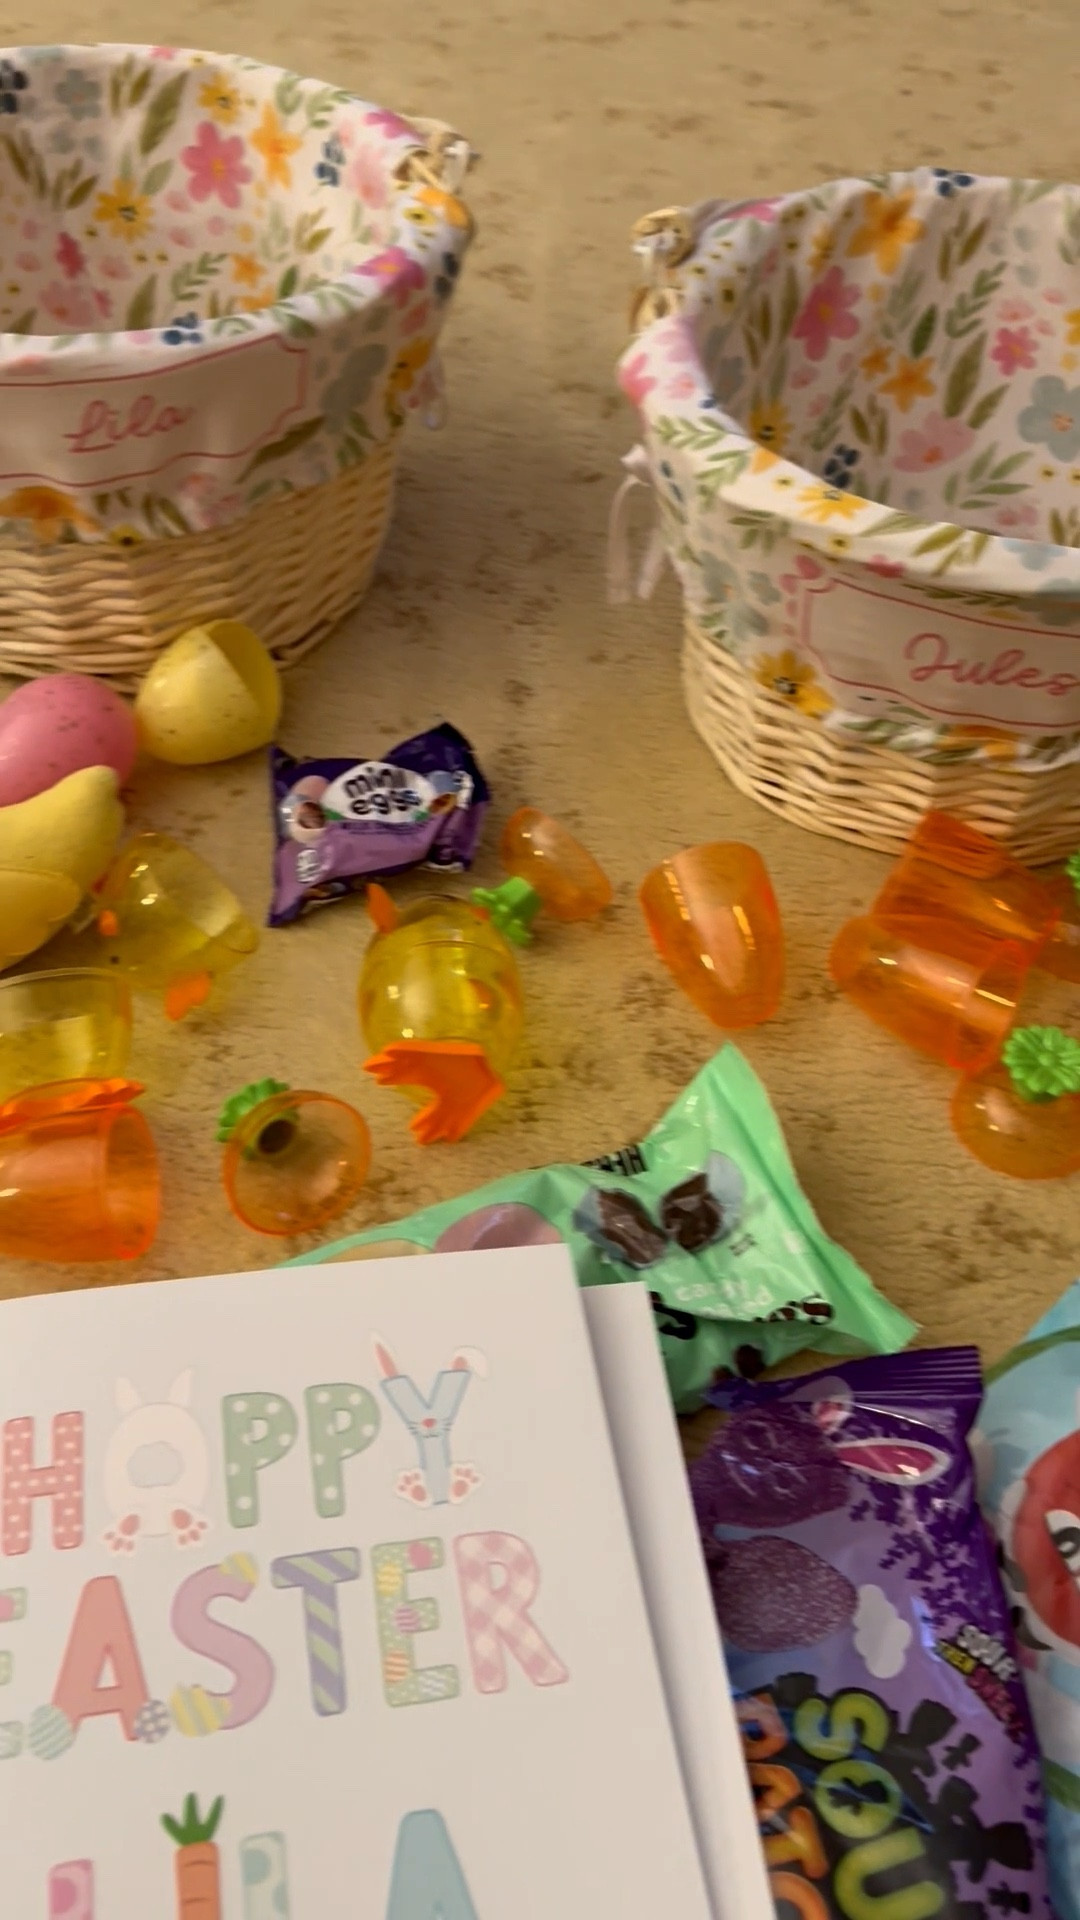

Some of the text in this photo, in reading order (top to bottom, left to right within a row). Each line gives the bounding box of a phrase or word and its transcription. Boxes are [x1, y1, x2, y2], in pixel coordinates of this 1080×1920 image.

[62, 395, 195, 453] Lila
[903, 632, 1080, 696] Jules
[343, 766, 408, 799] mini
[351, 789, 422, 816] eggs
[0, 1531, 569, 1759] ASTER
